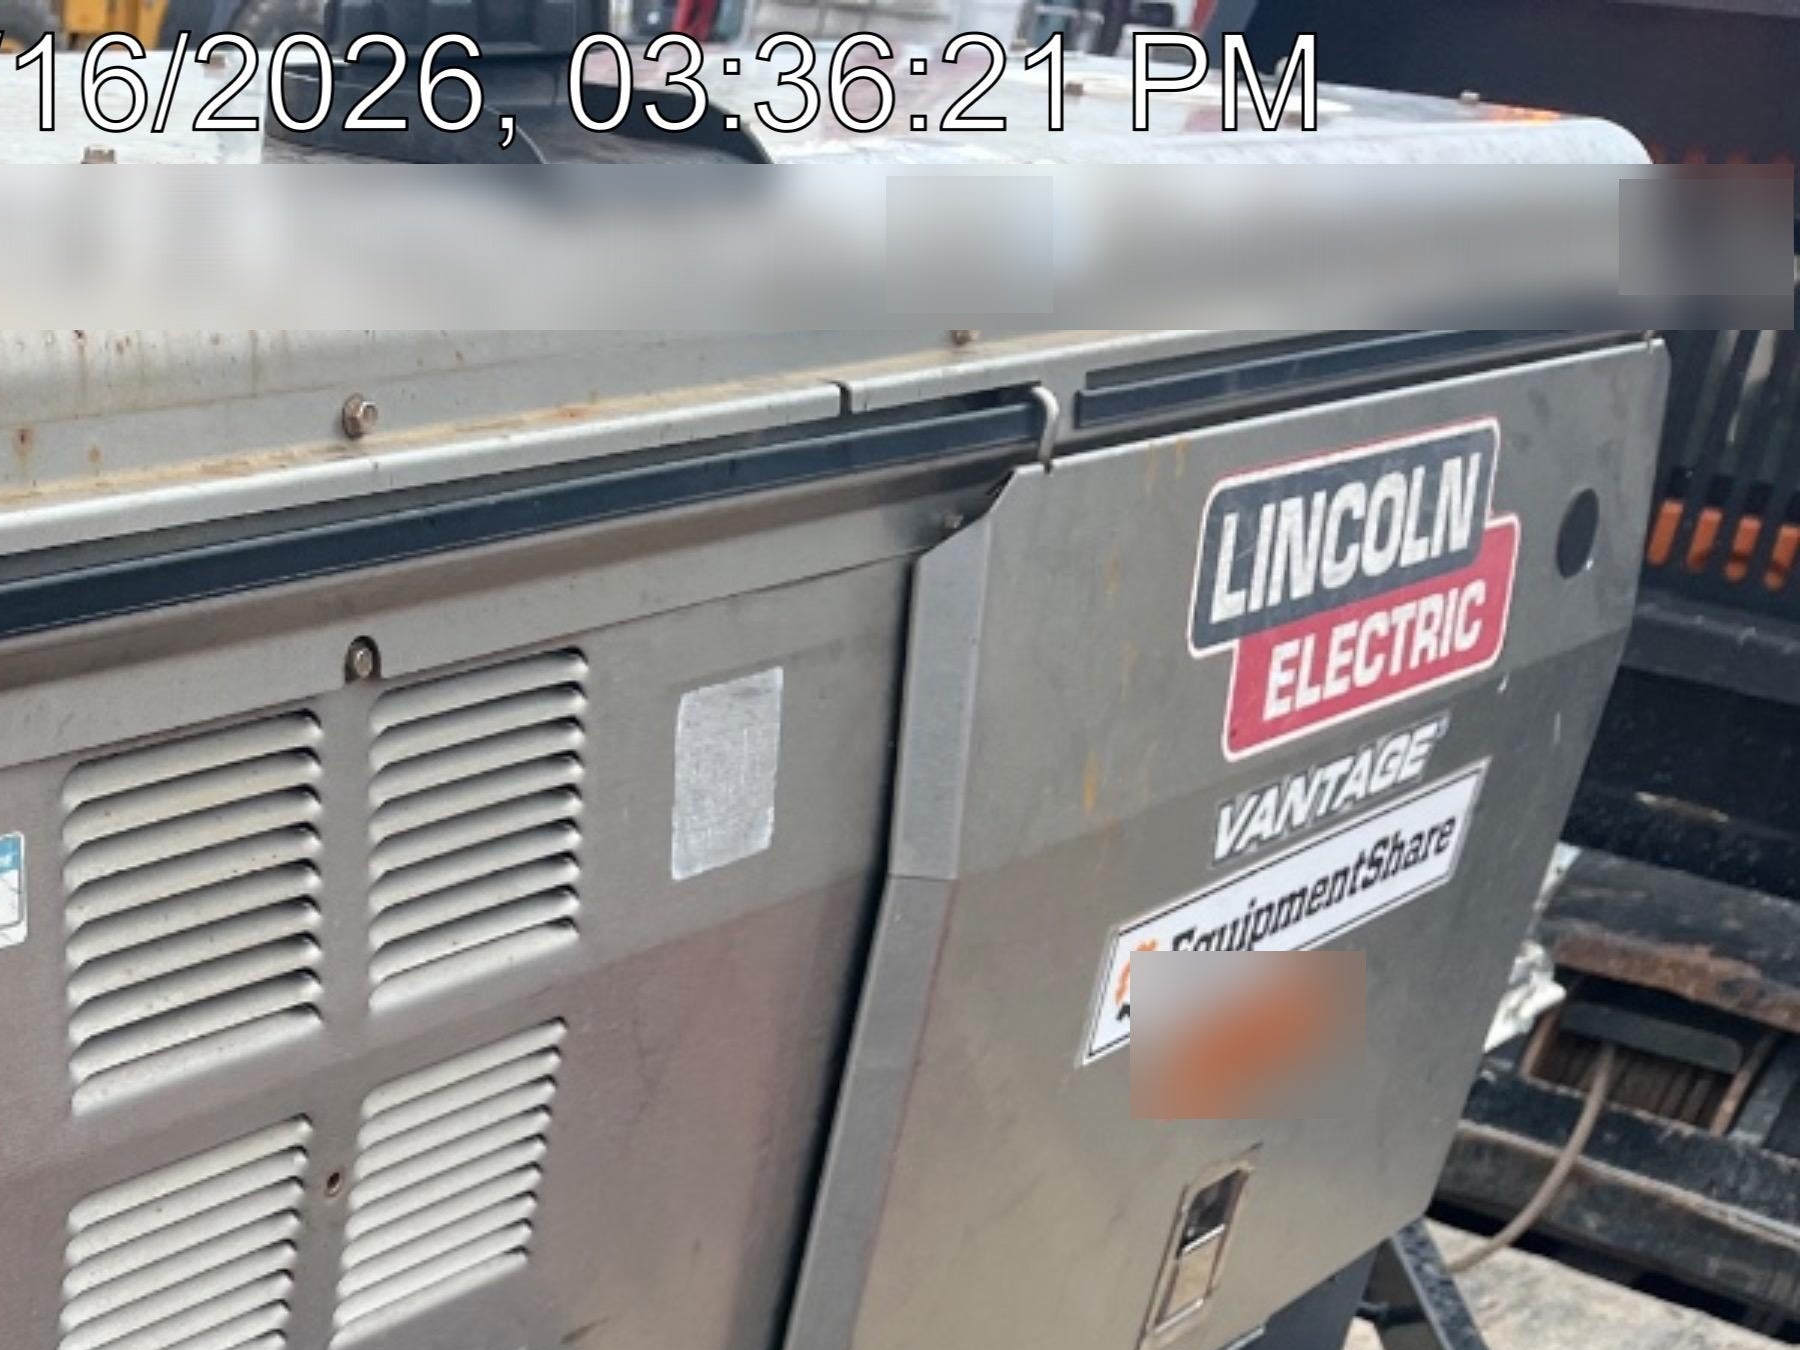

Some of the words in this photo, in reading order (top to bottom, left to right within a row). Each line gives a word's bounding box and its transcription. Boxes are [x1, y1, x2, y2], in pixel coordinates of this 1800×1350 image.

[1210, 453, 1482, 624] LINCOLN
[1263, 579, 1486, 722] ELECTRIC
[1214, 719, 1440, 860] VANTAGE
